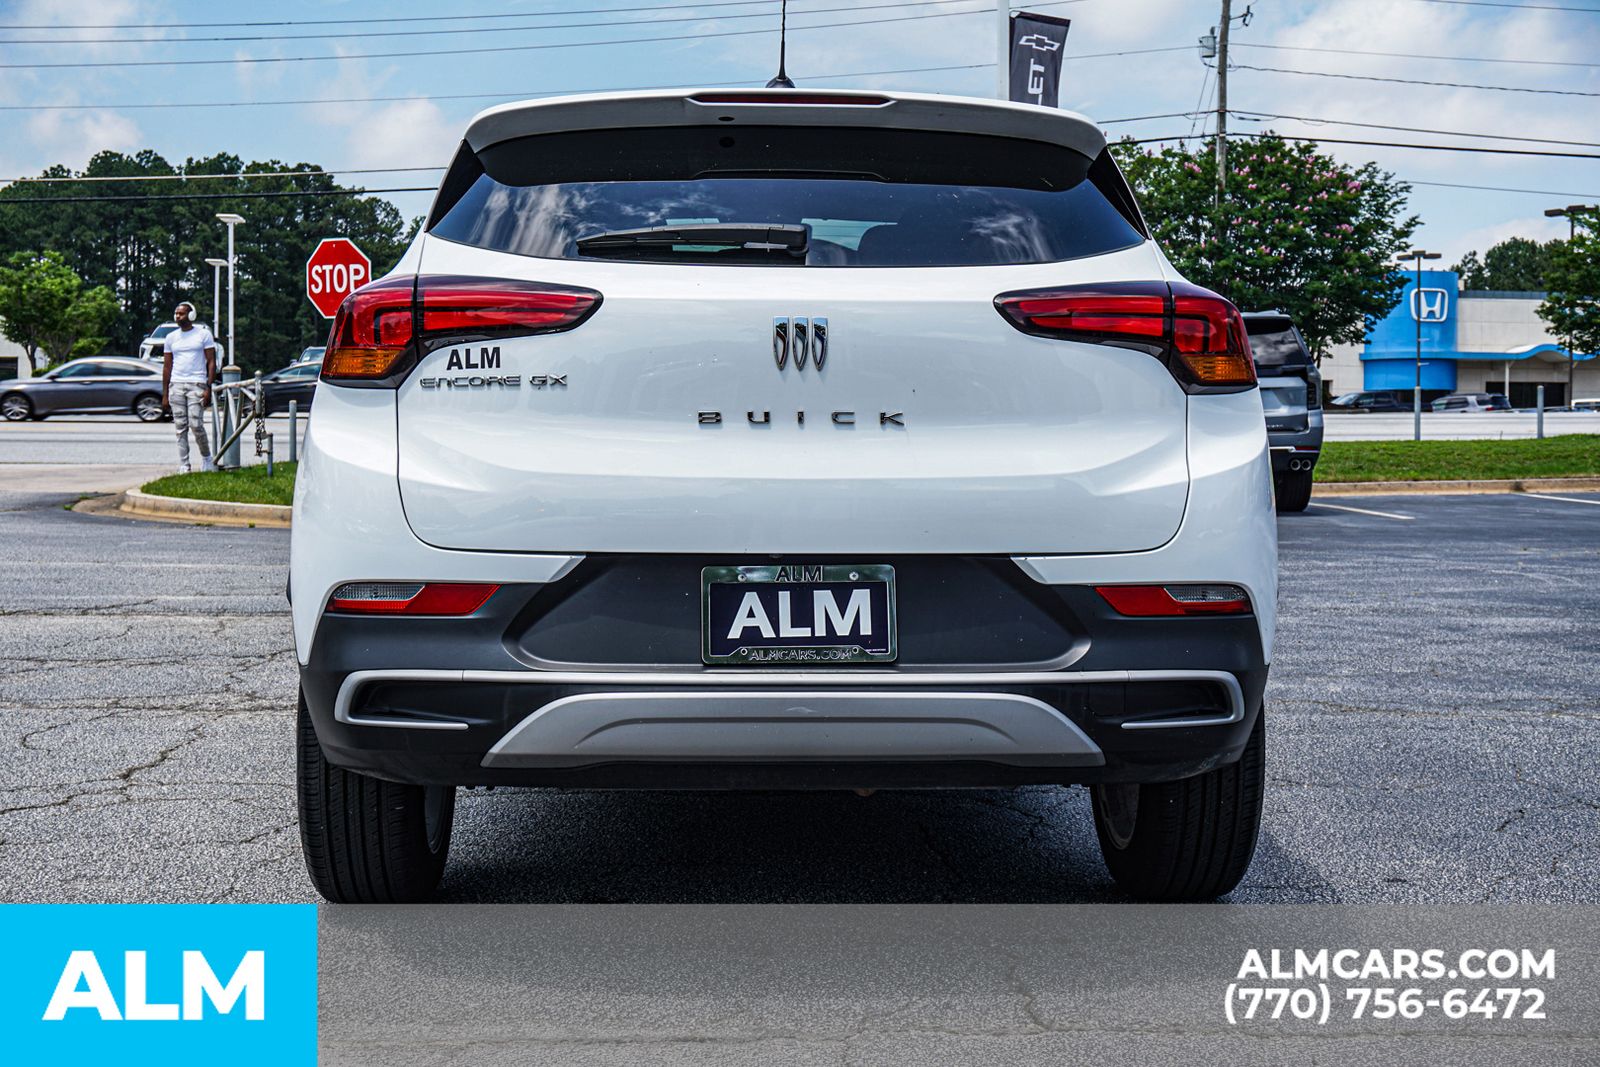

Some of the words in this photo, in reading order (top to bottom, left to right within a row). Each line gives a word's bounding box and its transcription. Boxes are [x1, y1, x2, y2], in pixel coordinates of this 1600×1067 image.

[311, 264, 366, 294] STOP
[446, 346, 501, 371] ALM
[529, 374, 568, 389] GX
[698, 410, 905, 427] BUICK
[774, 565, 824, 583] ALM
[727, 588, 873, 640] ALM
[748, 648, 853, 662] ALMCARS.COM
